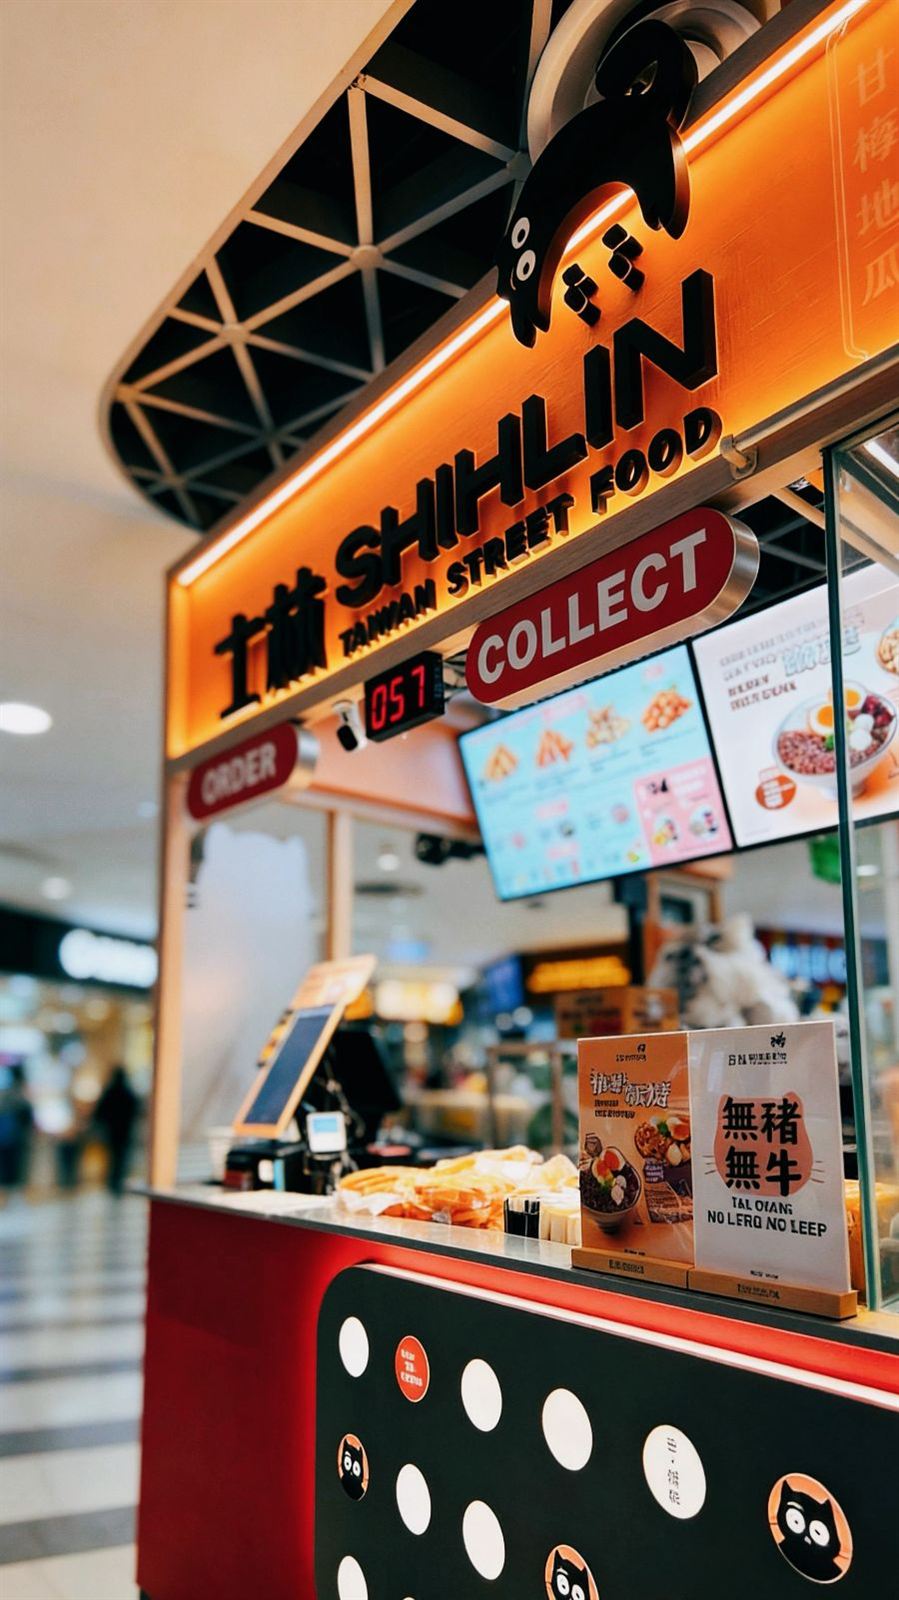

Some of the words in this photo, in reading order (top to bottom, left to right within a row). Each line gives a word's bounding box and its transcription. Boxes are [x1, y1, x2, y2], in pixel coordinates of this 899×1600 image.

[335, 268, 718, 608] SHIHLIN
[338, 579, 437, 657] TAIWAN
[447, 493, 574, 597] STREET
[590, 407, 722, 515] FOOD
[477, 528, 707, 684] COLLECT
[371, 665, 425, 731] 057
[201, 742, 277, 805] ORDER
[722, 1096, 802, 1145] 無豬
[725, 1146, 802, 1197] 無牛
[707, 1210, 725, 1225] NO
[766, 1217, 787, 1232] NO
